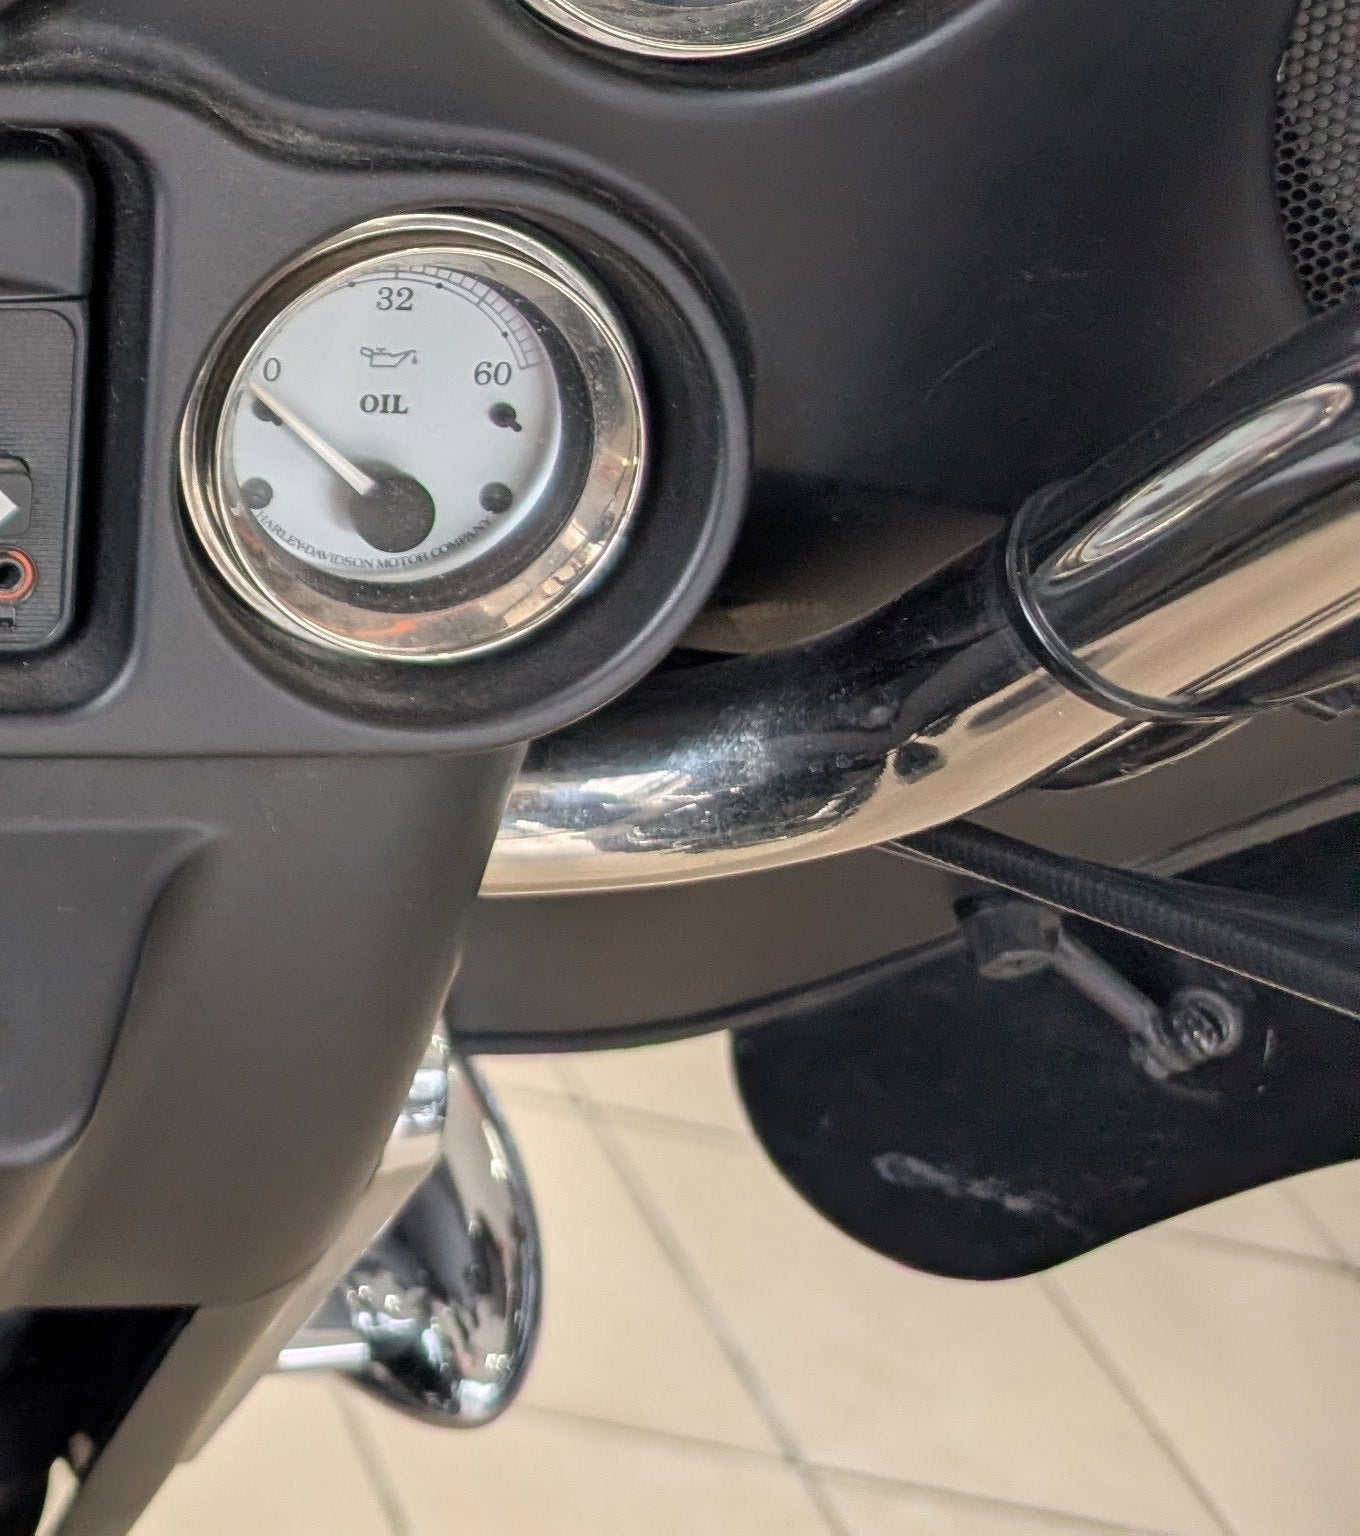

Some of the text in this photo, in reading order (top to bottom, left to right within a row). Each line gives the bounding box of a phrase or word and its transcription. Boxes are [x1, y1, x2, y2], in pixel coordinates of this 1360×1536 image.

[375, 287, 413, 312] 32
[263, 358, 281, 382] 0
[474, 361, 512, 386] 60
[359, 394, 409, 414] OIL
[257, 510, 492, 569] HARLEY-DAVIDSON MOTOR COMPANY
